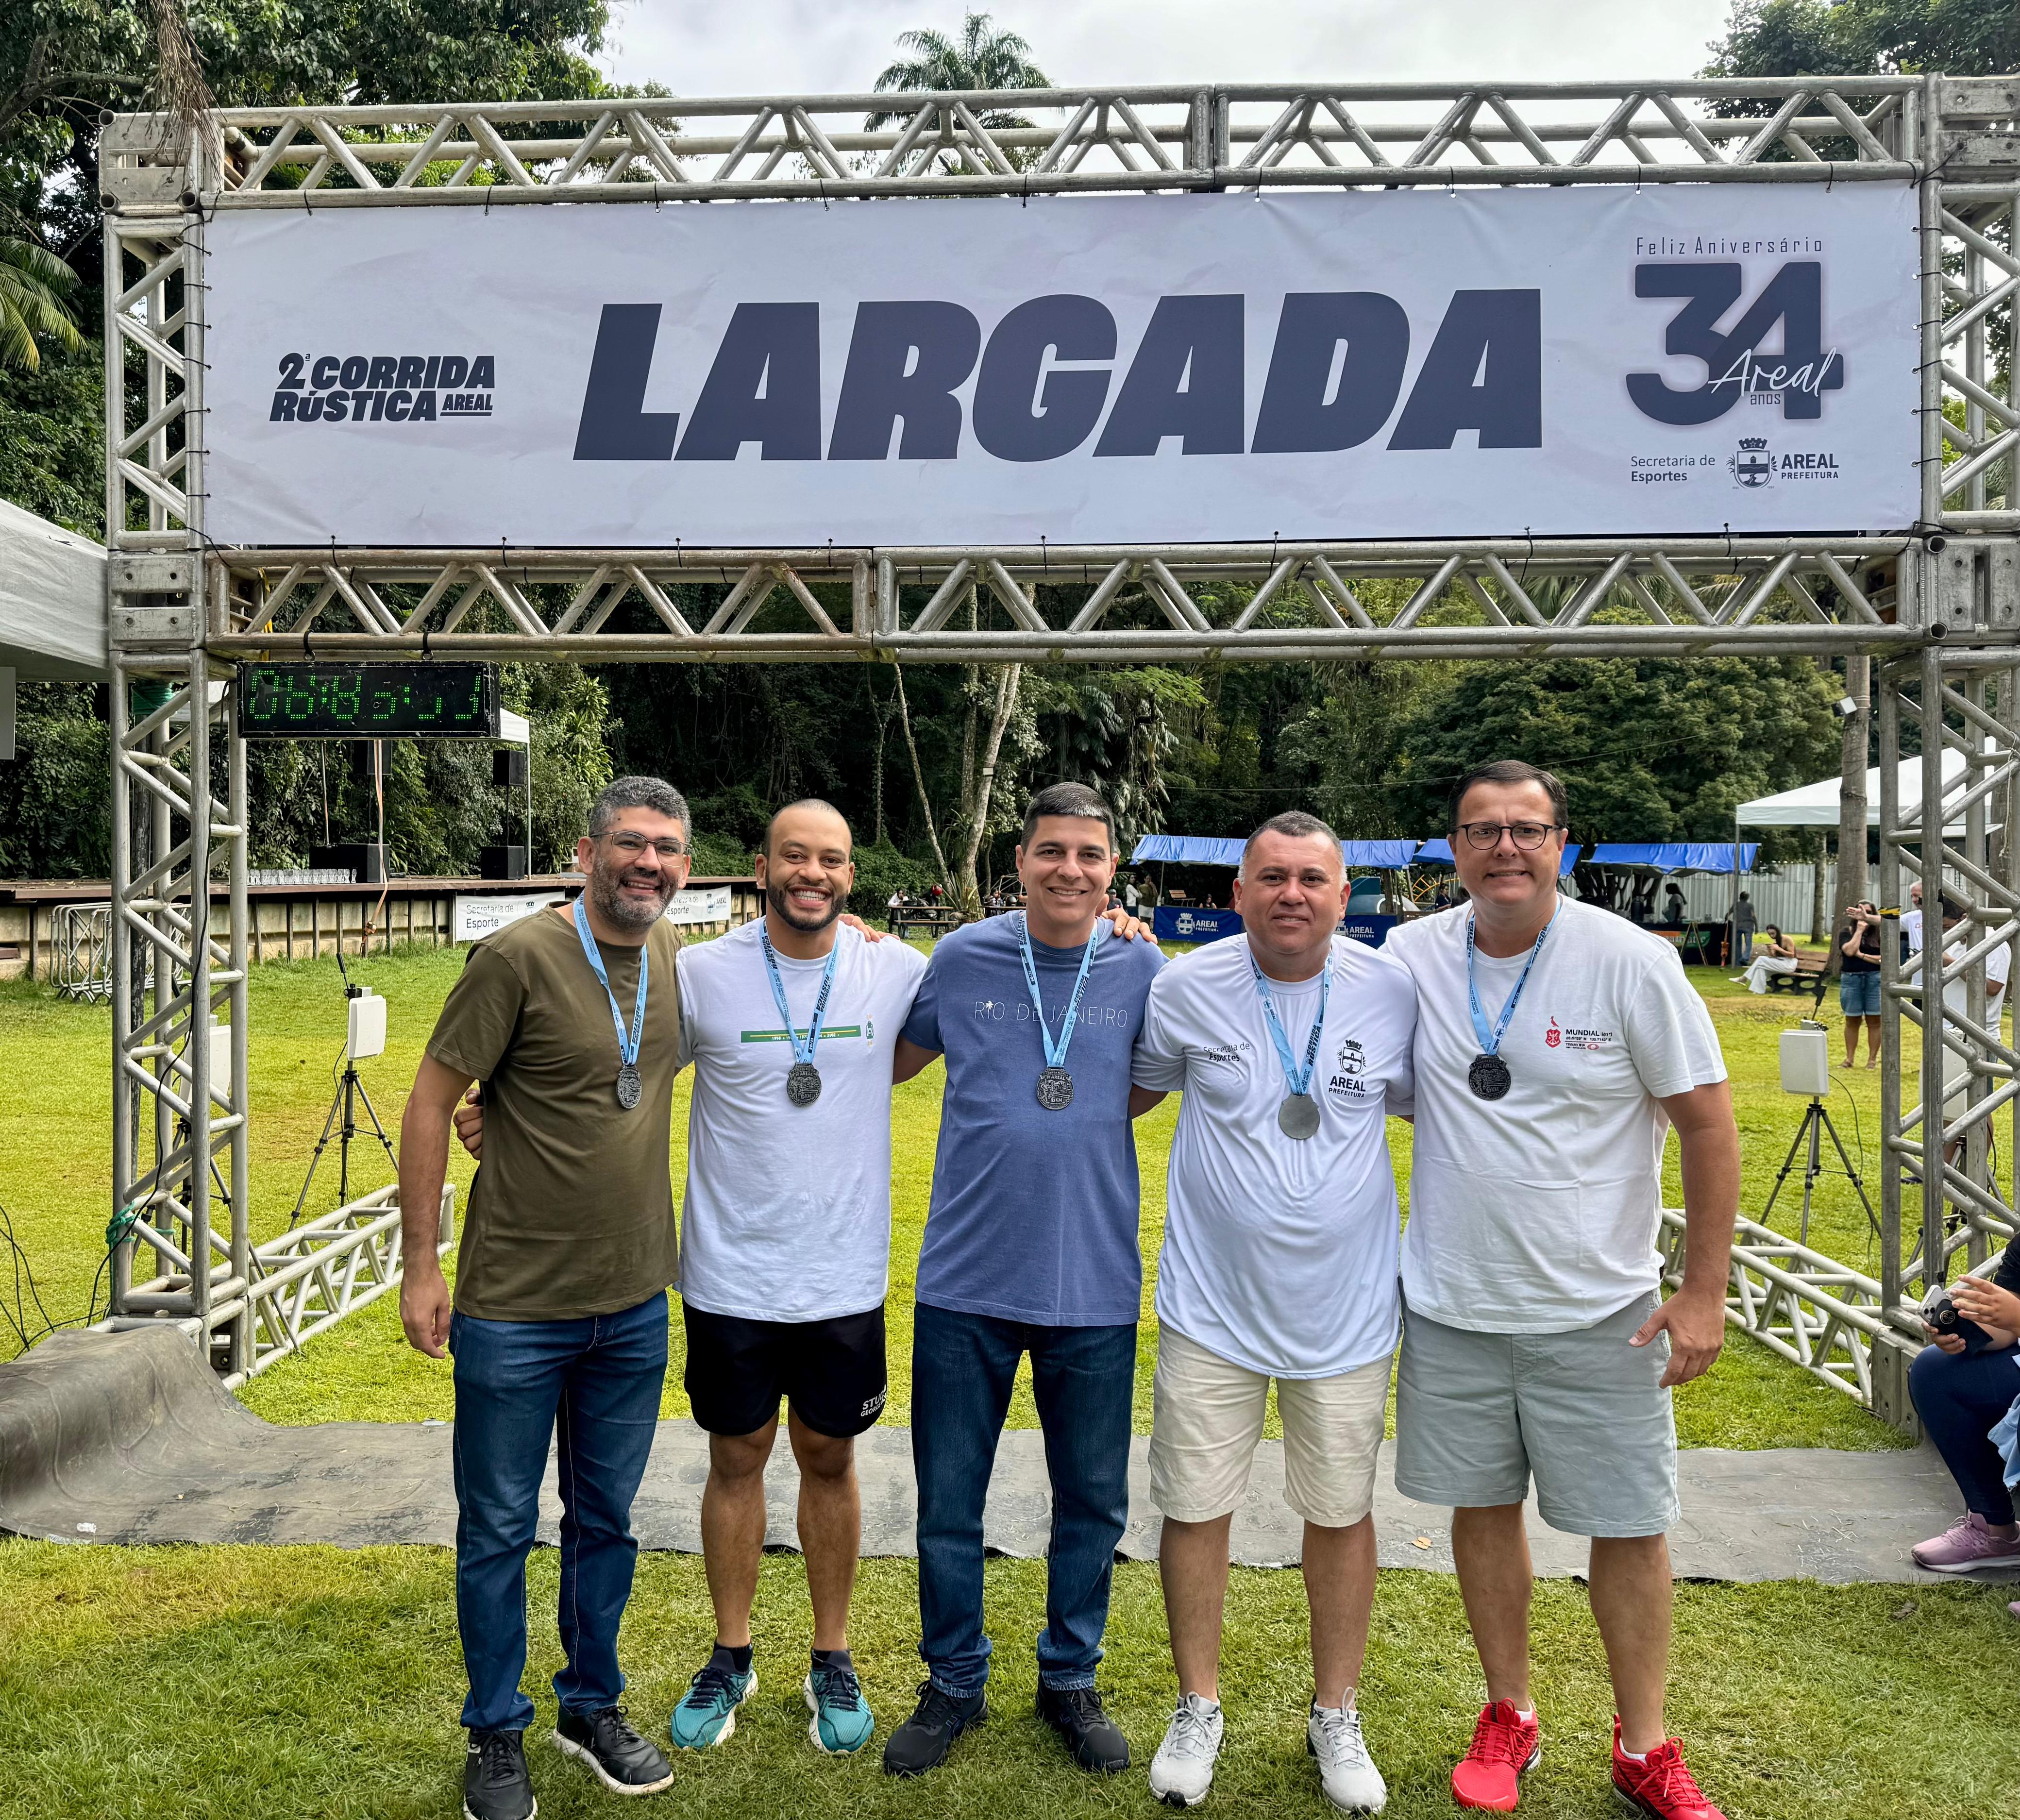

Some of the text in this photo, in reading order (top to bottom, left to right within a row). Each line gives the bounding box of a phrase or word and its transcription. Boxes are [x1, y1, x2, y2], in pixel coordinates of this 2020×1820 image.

[1637, 236, 1822, 255] Feliz Aniversário
[1626, 262, 1844, 425] 34
[311, 355, 495, 390] CORRIDA
[572, 288, 1542, 462] LARGADA
[1708, 347, 1837, 397] Areal
[269, 390, 437, 422] RÚSTICA
[442, 394, 493, 411] AREAL
[1750, 393, 1781, 405] anos
[1631, 455, 1716, 467] Secretaria de
[1781, 454, 1839, 469] AREAL
[1631, 471, 1687, 485] Esportes
[1781, 472, 1839, 480] PREFEITURA
[505, 904, 514, 912] de
[667, 906, 689, 916] Esporte
[467, 918, 499, 930] Esporte
[975, 1000, 1127, 1028] RIO DE JANEIRO
[1240, 1042, 1250, 1050] de
[1209, 1053, 1240, 1062] Esportes
[1330, 1076, 1366, 1092] AREAL
[1329, 1088, 1364, 1097] PREFEITURA
